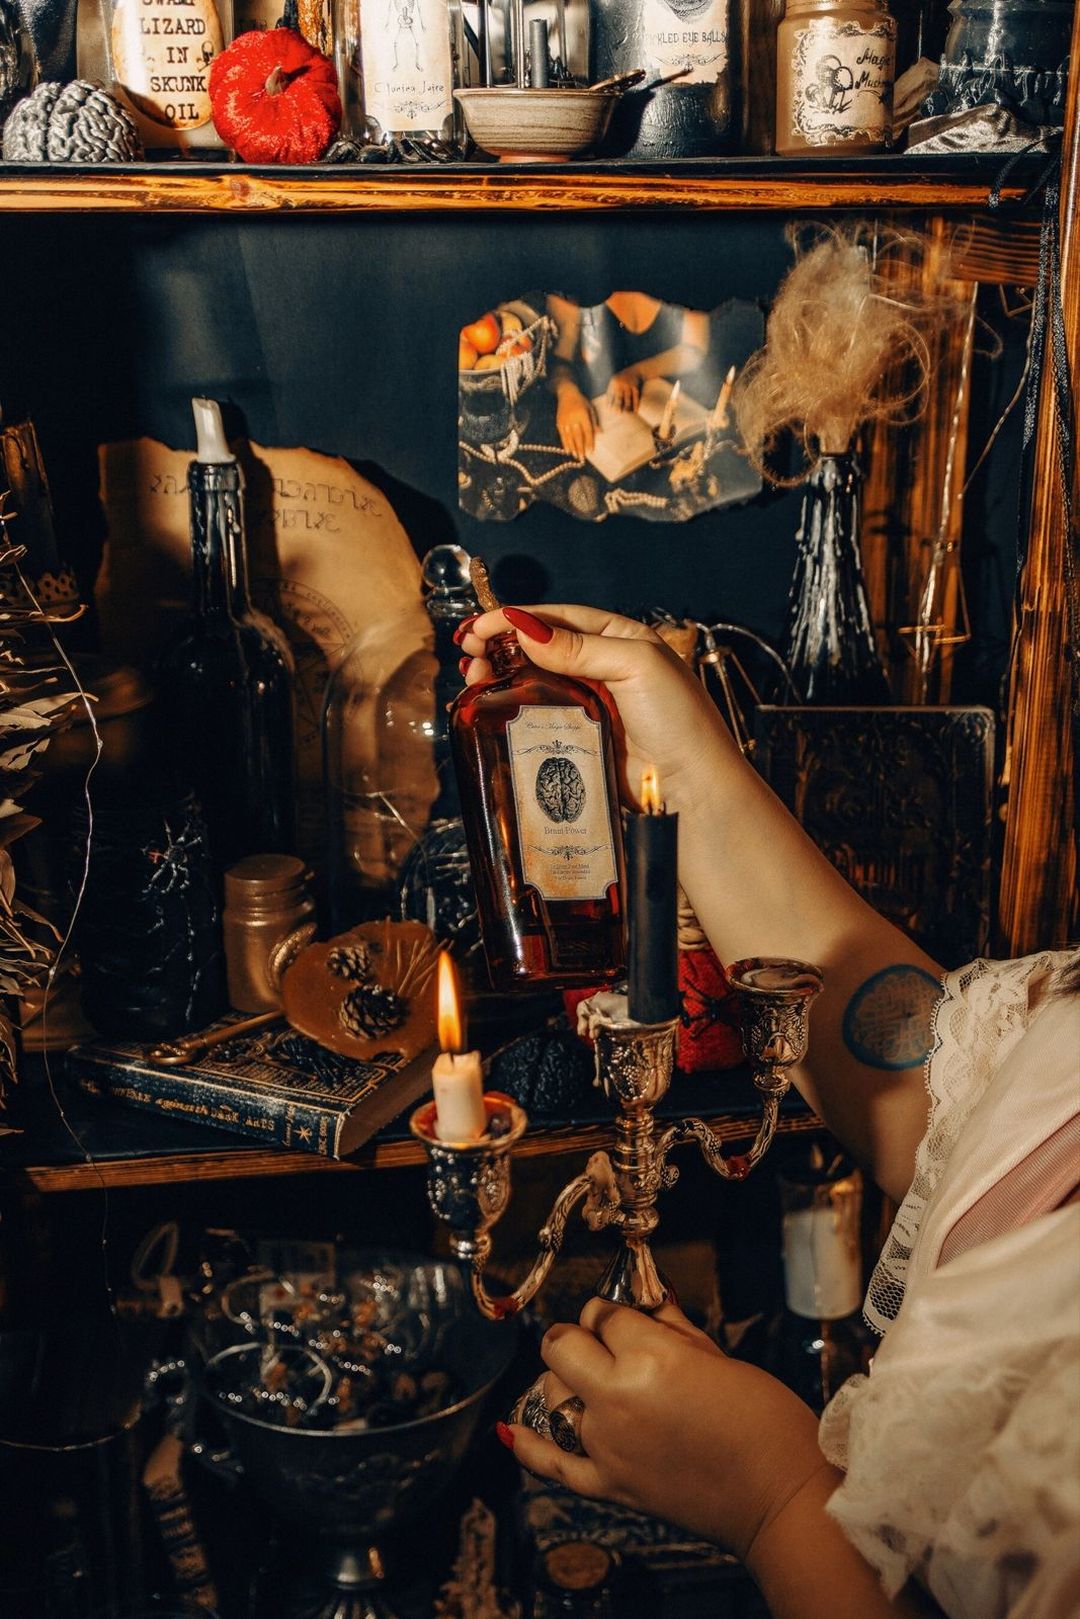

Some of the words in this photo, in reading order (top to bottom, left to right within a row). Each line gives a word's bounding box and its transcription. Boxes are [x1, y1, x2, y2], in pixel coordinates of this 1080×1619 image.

[140, 17, 206, 35] LIZARD
[166, 46, 189, 64] IN
[149, 76, 207, 93] SKUNK
[164, 103, 200, 120] OIL
